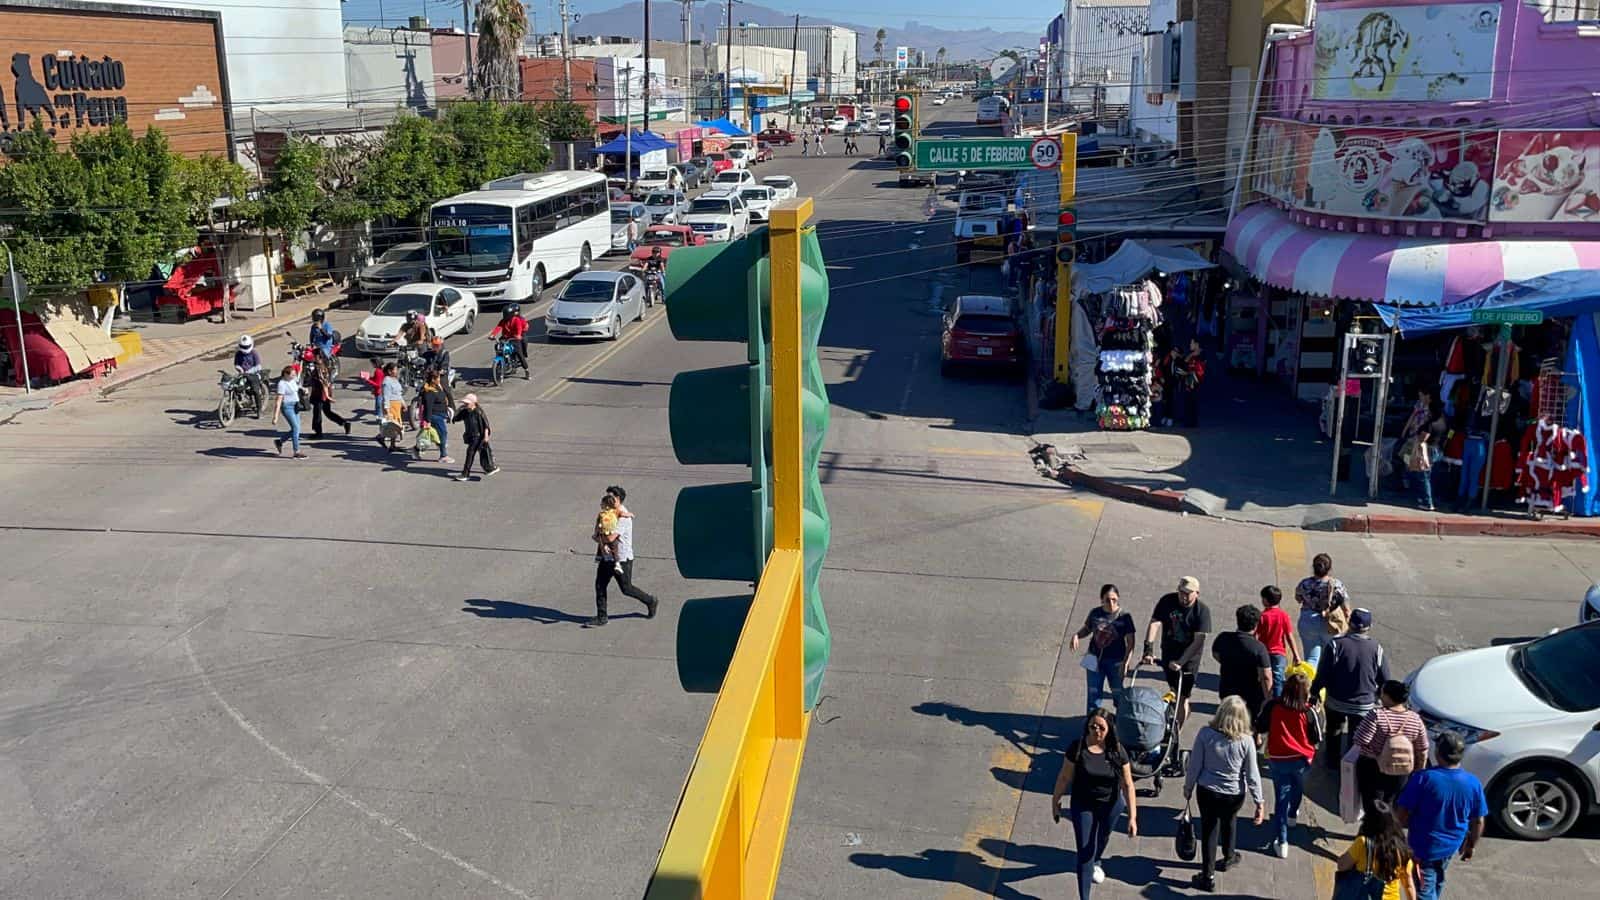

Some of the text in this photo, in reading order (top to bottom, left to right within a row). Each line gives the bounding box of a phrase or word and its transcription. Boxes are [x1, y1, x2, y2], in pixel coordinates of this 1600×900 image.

[42, 53, 125, 91] Cuidado
[73, 92, 128, 128] Perro
[929, 146, 1026, 163] CALLE 5 DE FEBRERO
[1036, 144, 1055, 159] 50
[1482, 312, 1495, 320] DE
[1496, 311, 1539, 321] FEBRERO
